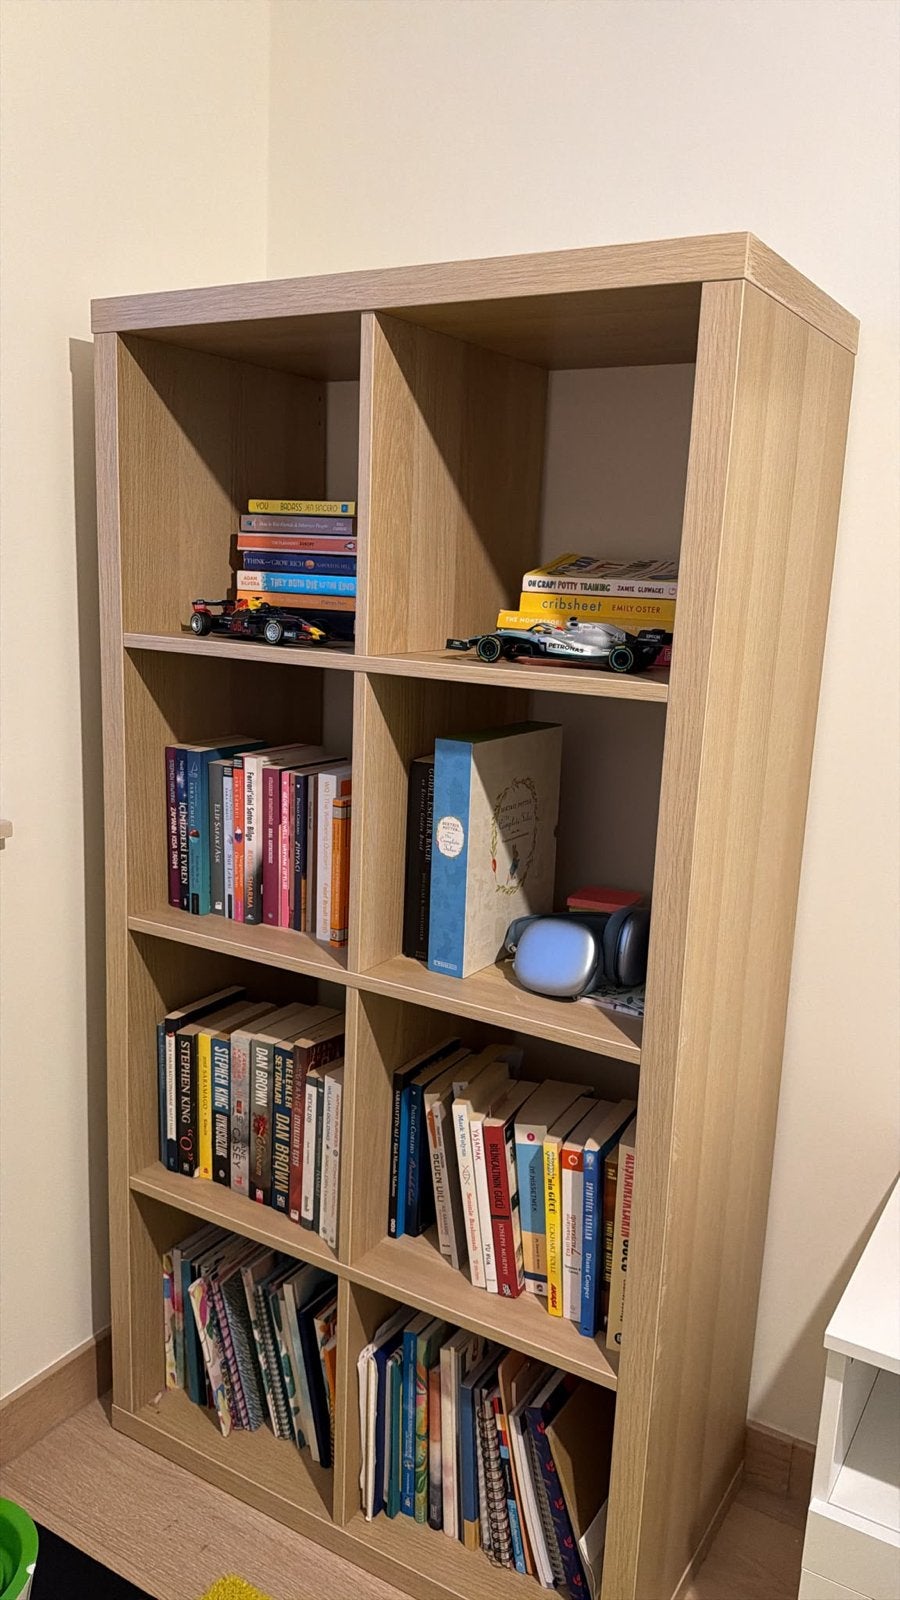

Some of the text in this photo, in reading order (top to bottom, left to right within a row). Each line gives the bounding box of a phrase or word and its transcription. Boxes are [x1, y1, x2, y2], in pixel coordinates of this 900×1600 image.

[256, 502, 269, 510] YOU
[280, 502, 303, 512] BADASS
[271, 578, 288, 587] THEY
[557, 581, 578, 591] POTTY
[580, 582, 611, 593] TRAINING
[617, 586, 664, 595] JAMIE GLOWACKI
[541, 598, 602, 612] cribsheet
[612, 605, 661, 614] EMILY OSTER
[548, 642, 585, 654] PETRONAS
[324, 781, 330, 793] WQ
[246, 772, 255, 842] Ferrari'sini Satan Bilge
[179, 802, 189, 852] İÇİMİZDEKİ
[181, 1041, 191, 1093] STEPHEN
[255, 1047, 268, 1106] DAN BROWN
[286, 1058, 294, 1108] MELEKLER
[181, 1096, 191, 1123] KING
[215, 1046, 229, 1158] STEPHEN KING UYKUSUZLUK
[272, 1112, 291, 1192] DAN BROWN
[490, 1144, 504, 1209] BİLİNÇALTININ GÜCÜ
[549, 1192, 558, 1214] GÜCÜ
[585, 1182, 595, 1240] SPİRİTÜEL YASALAR
[485, 1243, 491, 1252] YU
[498, 1223, 509, 1275] JOSEPH MURPHY
[549, 1223, 557, 1253] ECKHART
[584, 1275, 592, 1299] Cooper
